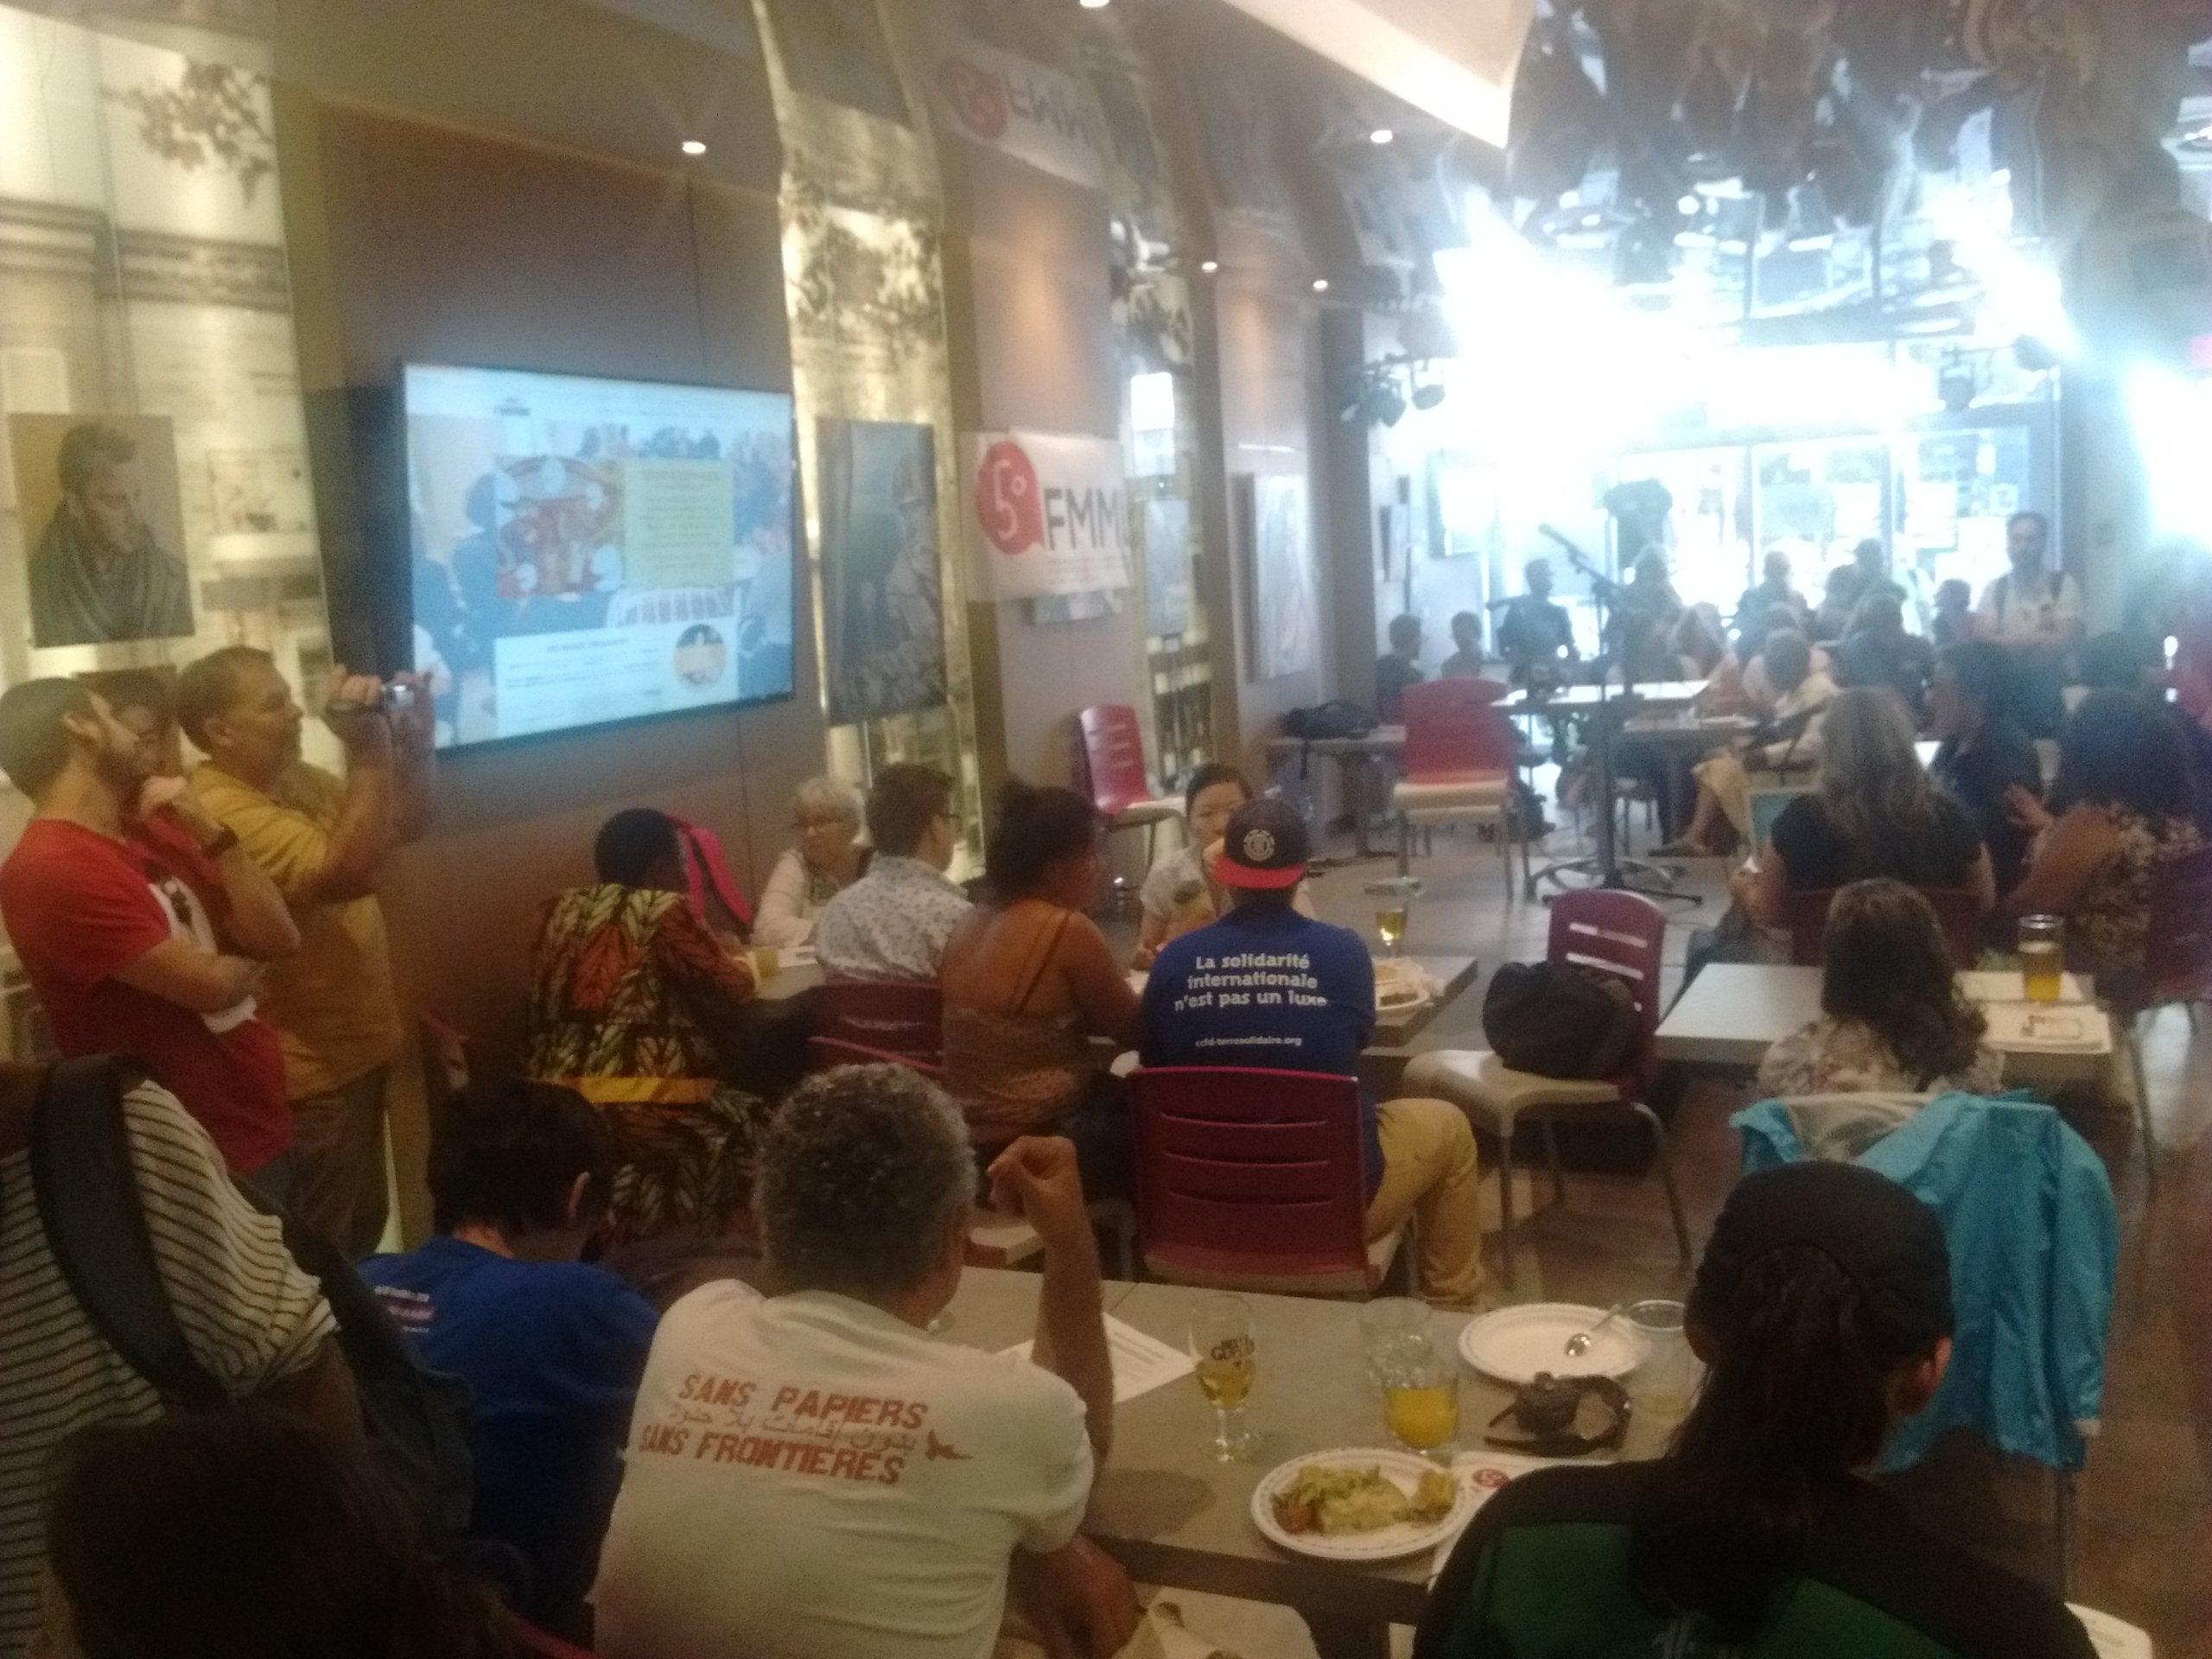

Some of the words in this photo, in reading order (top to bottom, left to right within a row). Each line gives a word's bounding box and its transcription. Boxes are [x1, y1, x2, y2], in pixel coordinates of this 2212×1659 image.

[1196, 956, 1216, 969] La
[1221, 953, 1310, 969] solidarité
[1187, 971, 1319, 989] internationale
[1174, 992, 1213, 1012] n'est
[1218, 992, 1251, 1007] pas
[1256, 991, 1281, 1005] un
[1288, 990, 1328, 1007] luxe
[678, 1374, 757, 1407] SANS
[771, 1384, 929, 1429] PAPIERS
[694, 1431, 906, 1484] FRONTIERES
